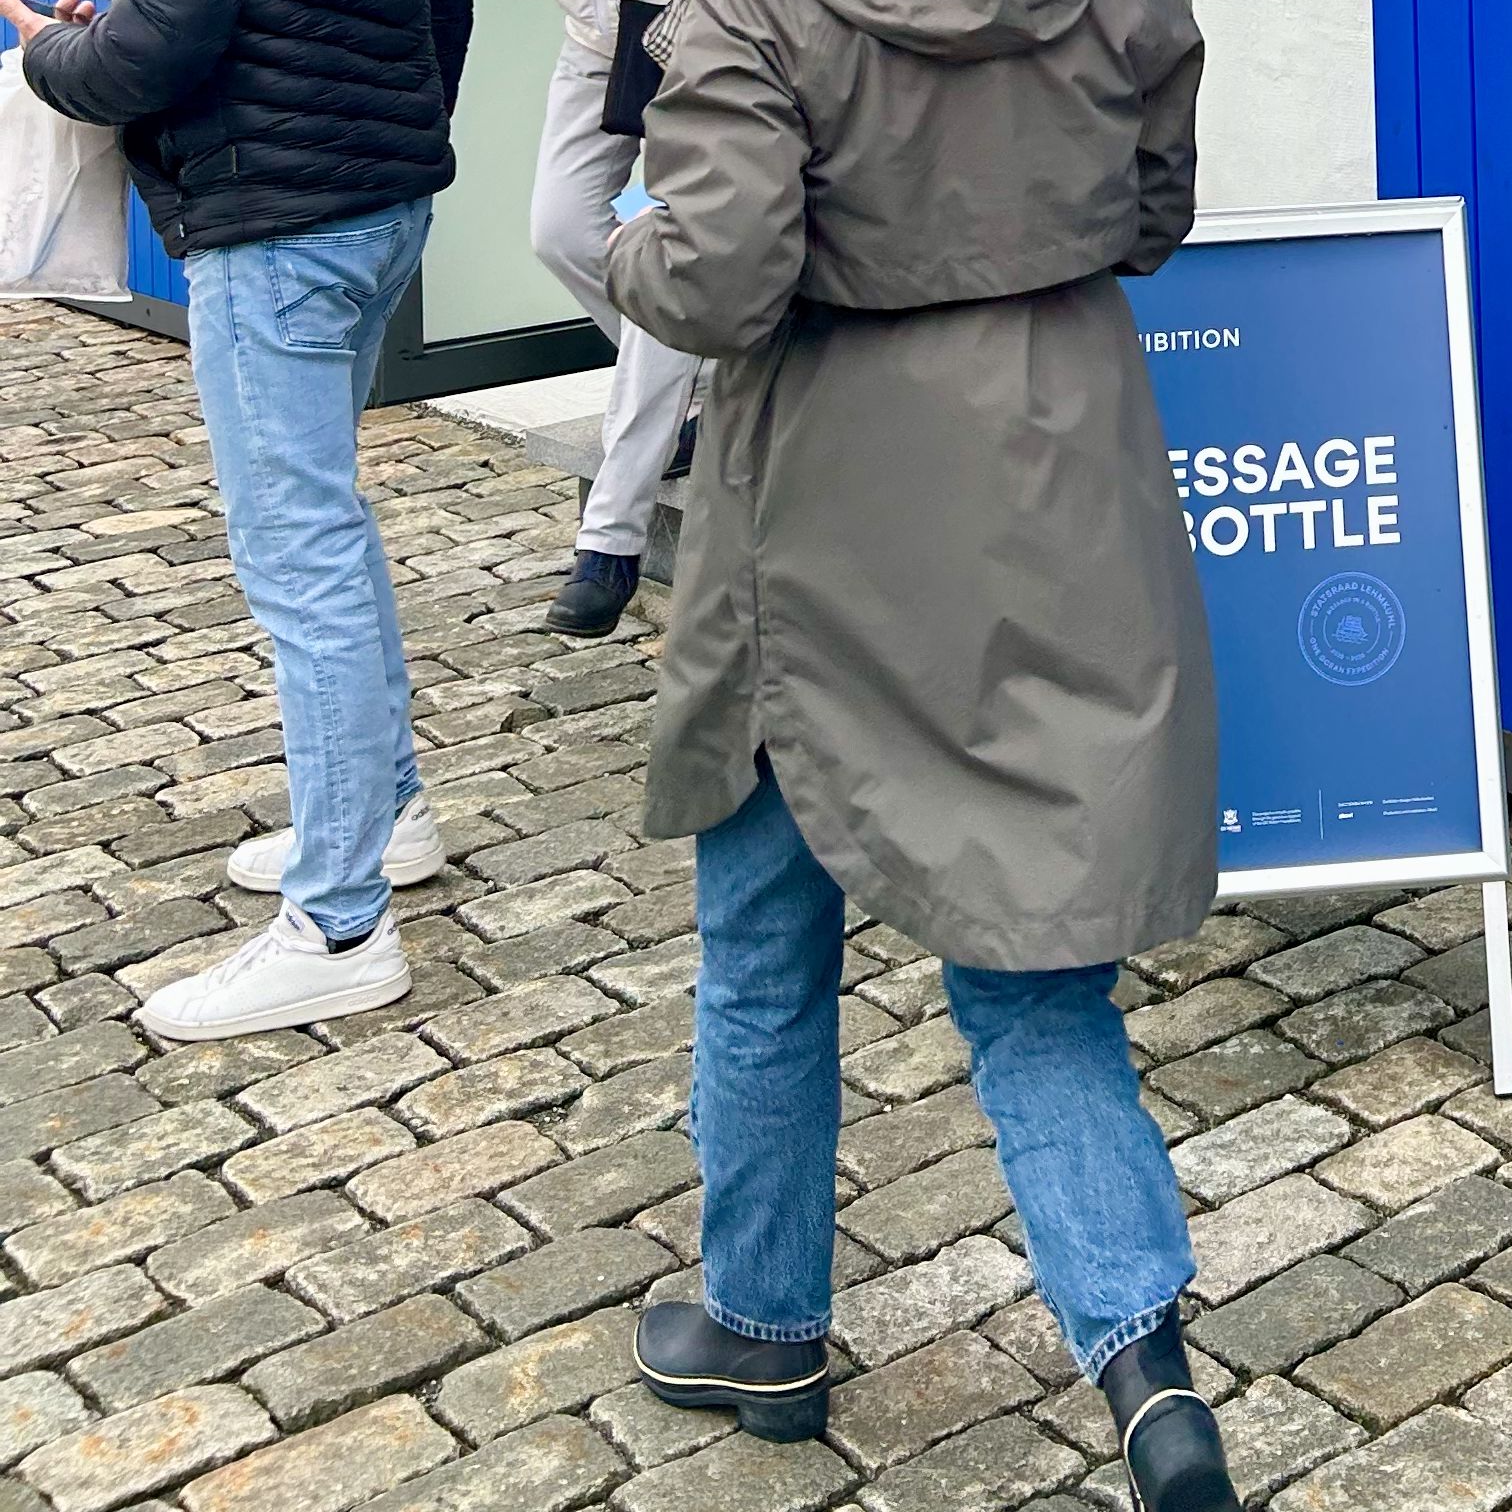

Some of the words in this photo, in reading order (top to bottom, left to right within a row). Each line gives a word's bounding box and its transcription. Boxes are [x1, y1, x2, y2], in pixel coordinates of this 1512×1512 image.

[1138, 328, 1239, 352] IBITION
[1168, 436, 1397, 498] ESSAGE
[1183, 495, 1400, 556] OTTLE
[1311, 582, 1358, 617] STATSRAAD
[1361, 584, 1396, 628] LEHMKUHL
[1319, 654, 1344, 674] OCEAN
